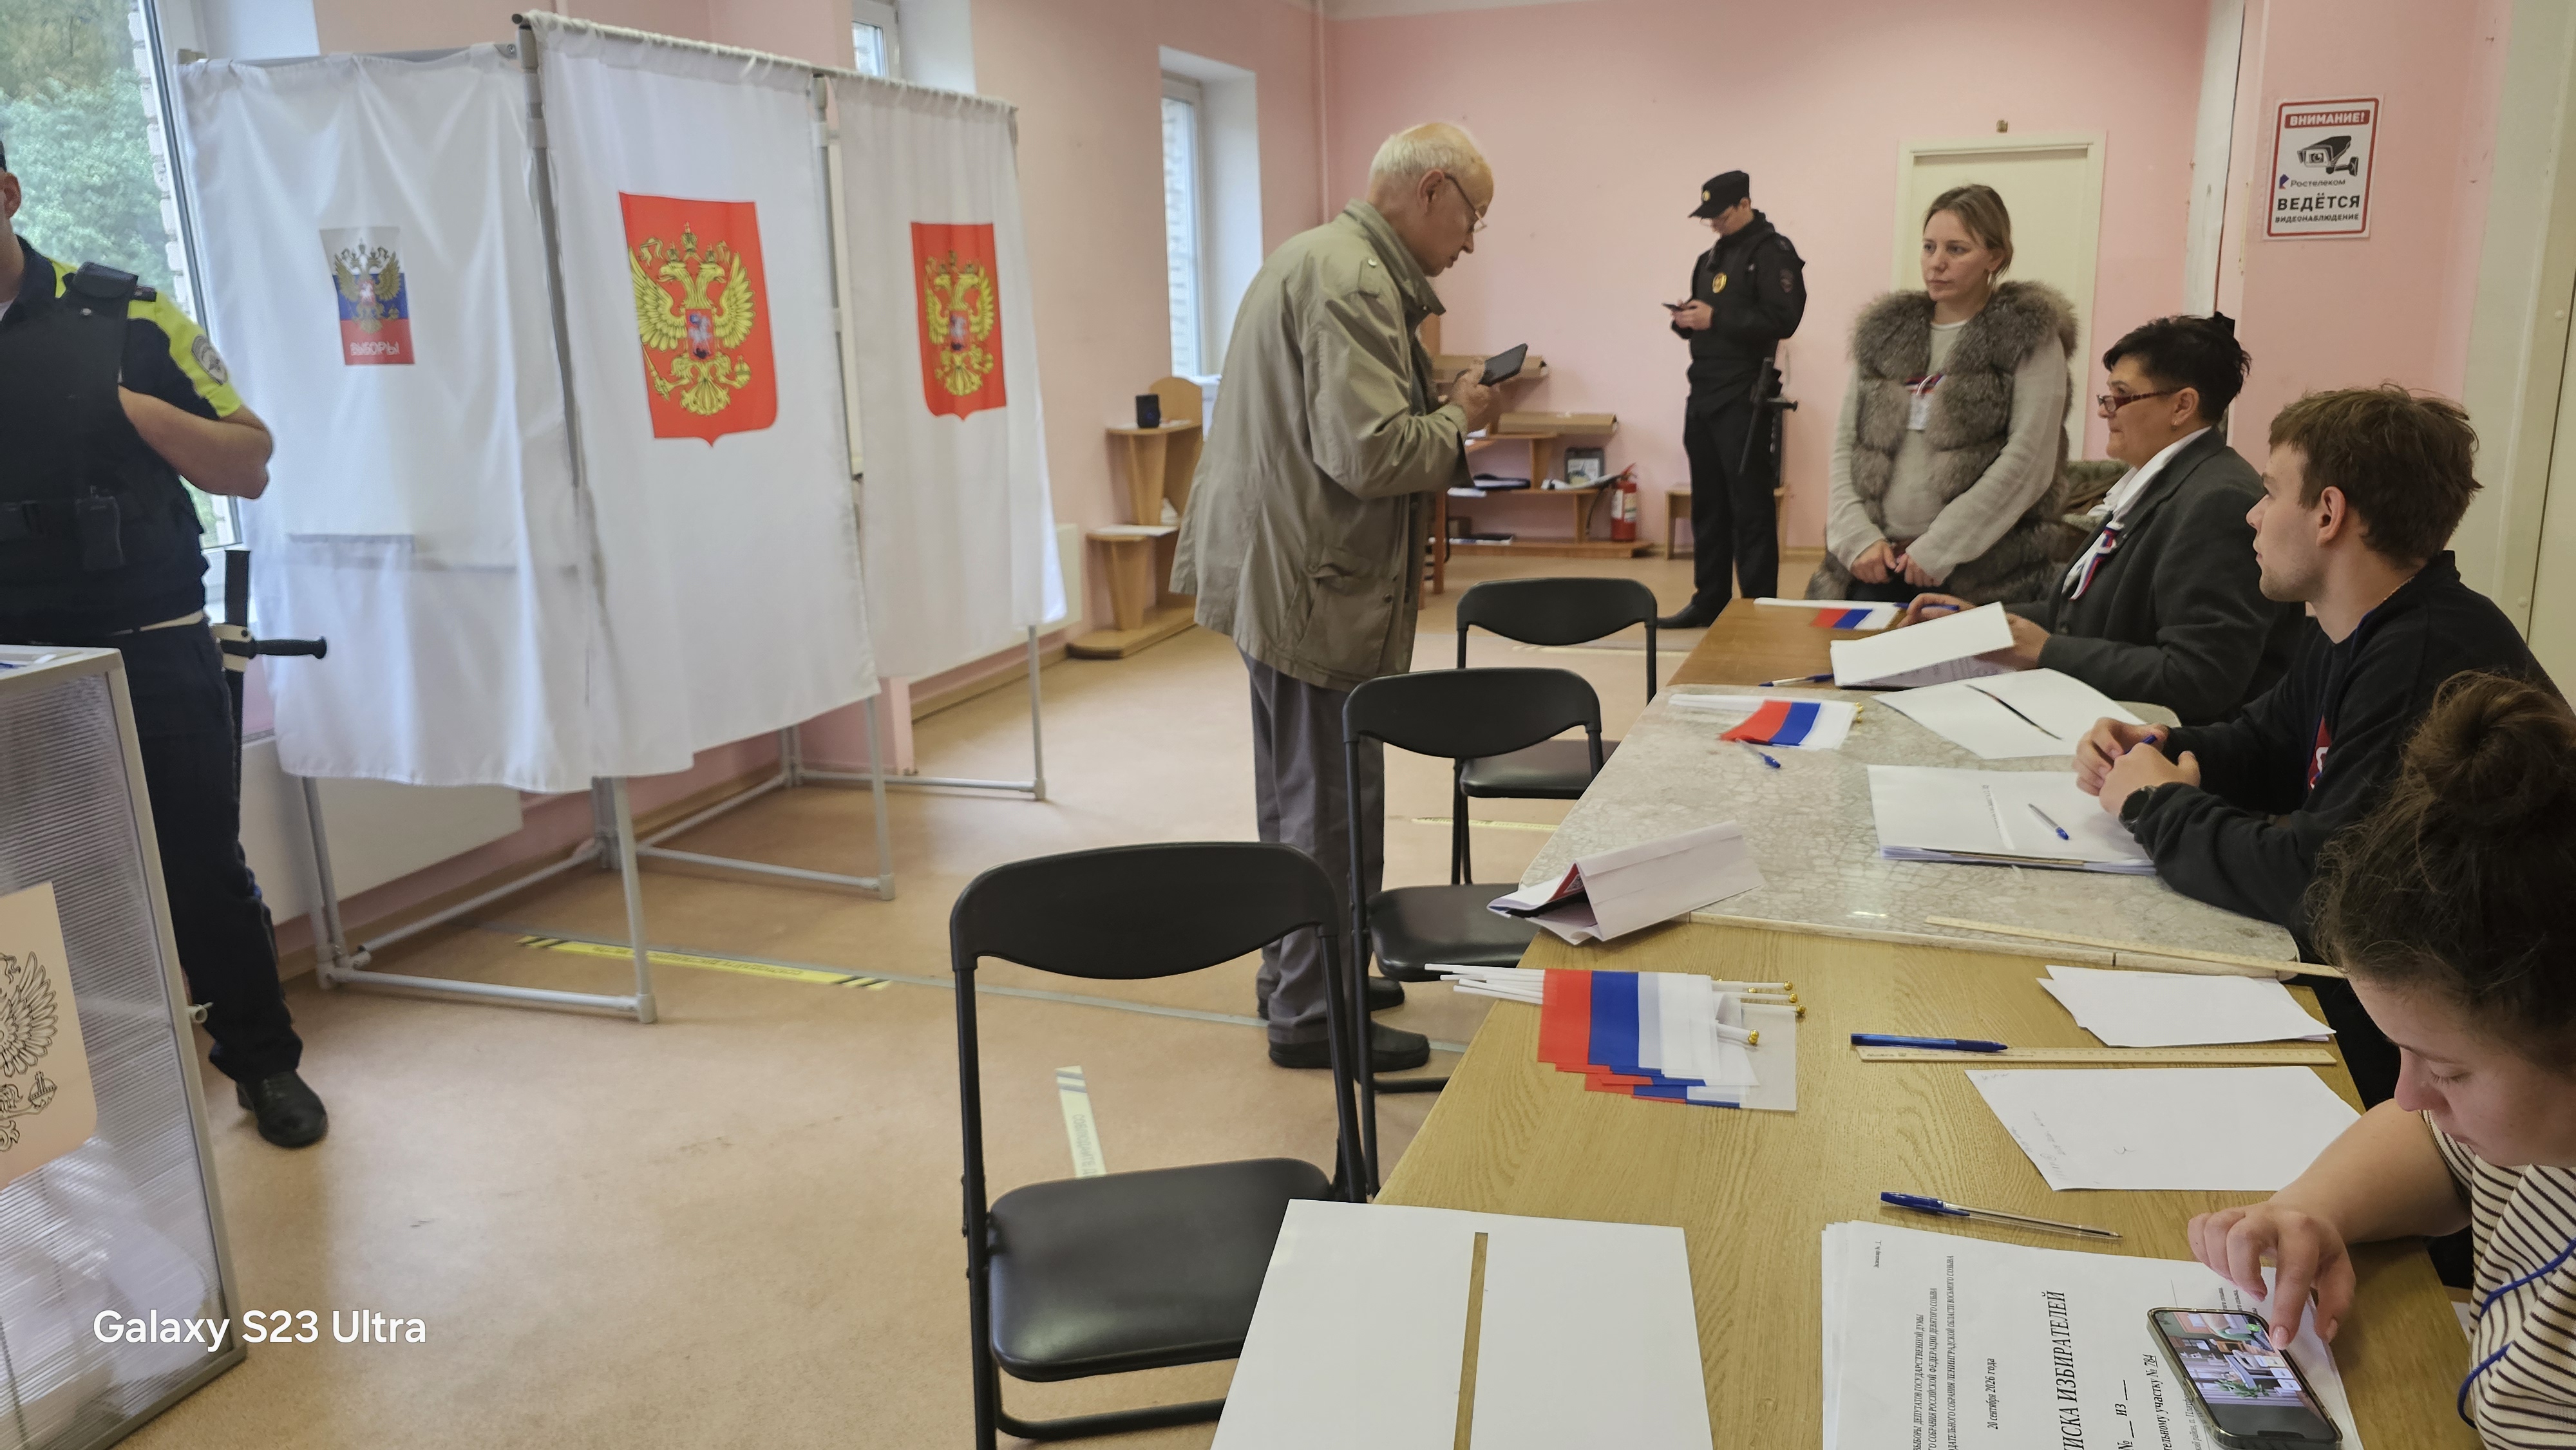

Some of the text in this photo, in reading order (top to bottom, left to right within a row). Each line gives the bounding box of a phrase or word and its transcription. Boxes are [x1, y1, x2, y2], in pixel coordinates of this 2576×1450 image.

[2290, 111, 2365, 126] ВНИМАНИЕ!
[2290, 178, 2346, 188] Ростелеком
[2277, 193, 2360, 212] ВЕДЁТСЯ
[2275, 213, 2359, 223] ВИДЕОНАБЛЮДЕНИЕ
[350, 341, 400, 356] ВЫБОРЫ
[1916, 1314, 1925, 1331] ДУМЫ
[1929, 1307, 1938, 1334] ДЕВЯТОГО
[1913, 1332, 1924, 1391] ГОСУДАРСТВЕННОЙ
[1929, 1334, 1938, 1373] ФЕДЕРАЦИИ
[1946, 1328, 1956, 1382] ЛЕНИНГРАДСКОЙ
[2143, 1354, 2157, 1368] 784
[1987, 1358, 1997, 1375] года
[2041, 1290, 2084, 1450] ИСКА ИЗБИРАТЕЛЕЙ
[2146, 1368, 2158, 1377] №
[1927, 1374, 1937, 1411] РОССИЙСКОЙ
[1985, 1376, 1995, 1393] 2026
[2150, 1378, 2168, 1414] участку
[1947, 1382, 1955, 1411] СОБРАНИЯ
[1985, 1393, 2000, 1420] сентября
[1913, 1392, 1924, 1425] ДЕПУТАТОВ
[2114, 1404, 2127, 1417] из
[1928, 1412, 1937, 1442] СОБРАНИЯ
